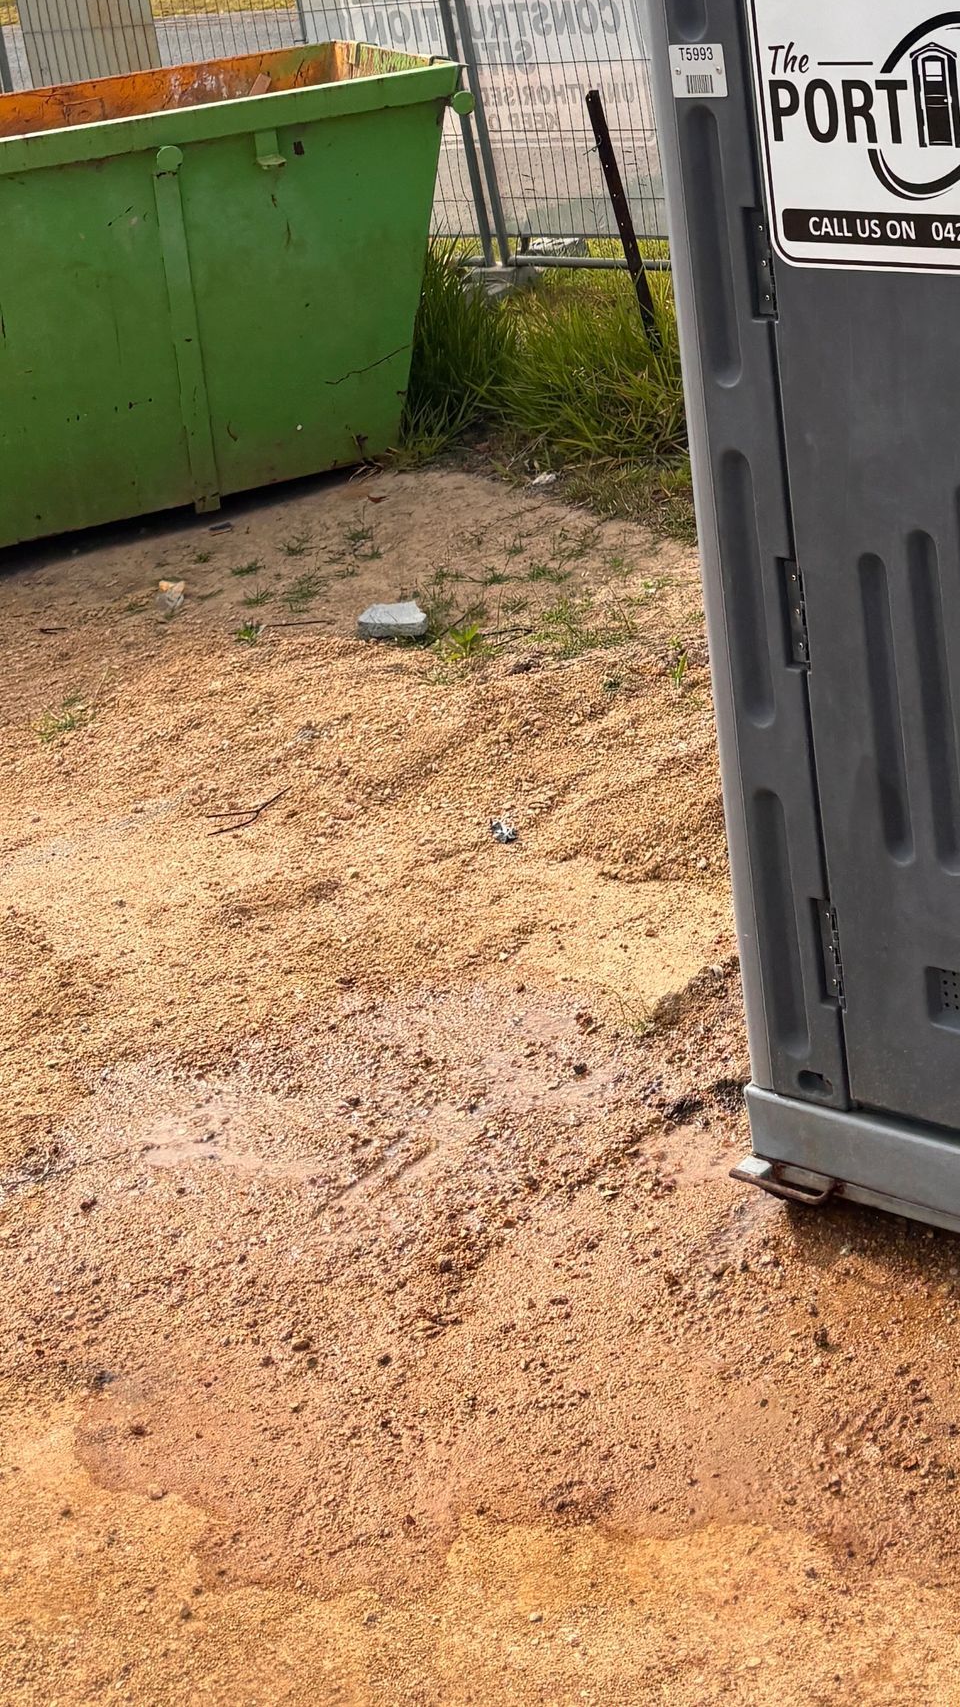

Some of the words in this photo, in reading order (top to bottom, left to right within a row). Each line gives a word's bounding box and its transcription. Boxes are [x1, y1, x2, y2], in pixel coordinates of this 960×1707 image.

[678, 46, 714, 61] T5993
[767, 41, 810, 76] The
[808, 216, 853, 238] CALL
[856, 217, 882, 239] US
[886, 219, 917, 241] ON
